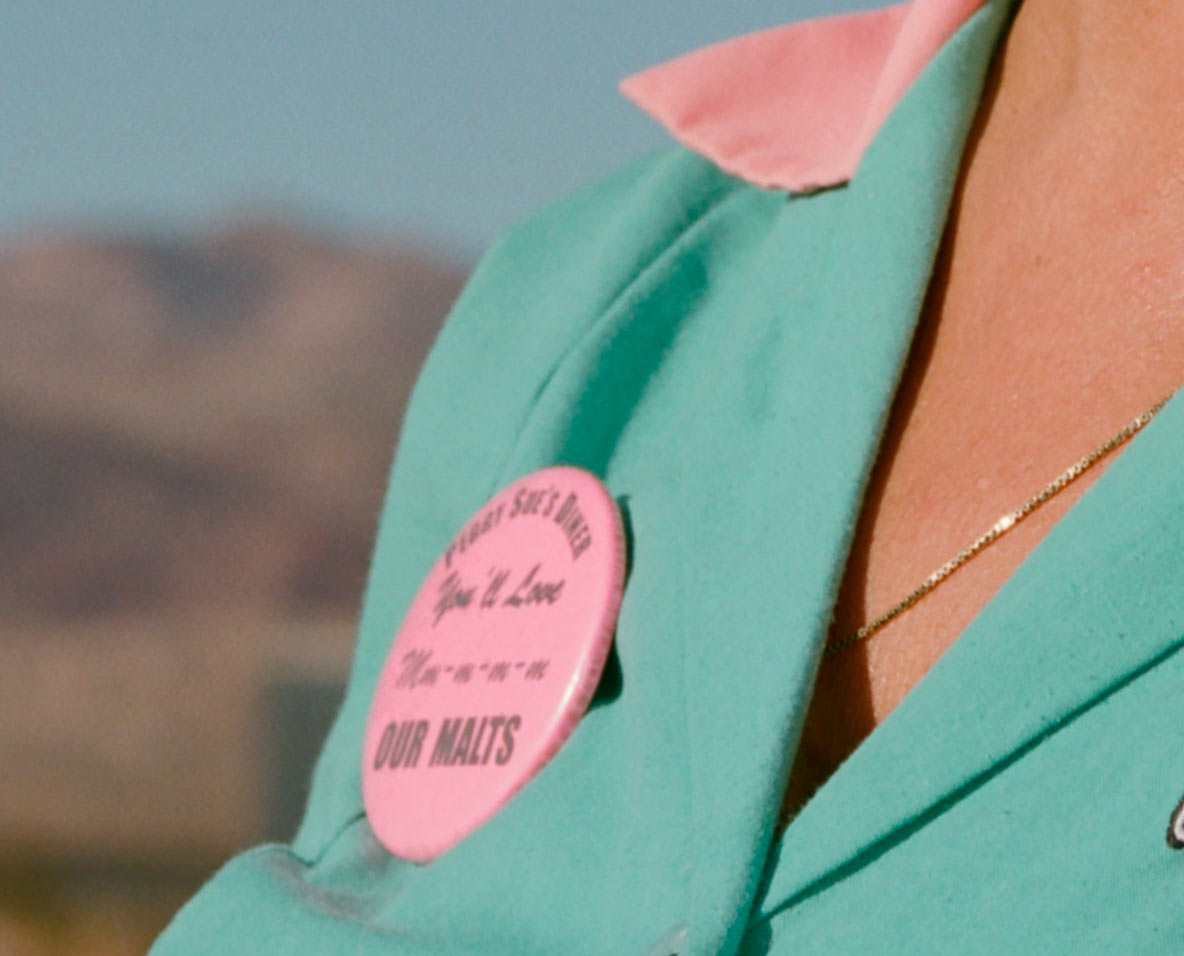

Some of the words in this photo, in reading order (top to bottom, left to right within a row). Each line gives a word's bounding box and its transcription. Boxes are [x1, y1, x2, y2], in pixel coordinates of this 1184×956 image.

[503, 562, 567, 606] Love
[373, 720, 430, 771] OUR
[428, 714, 523, 768] MALTS
